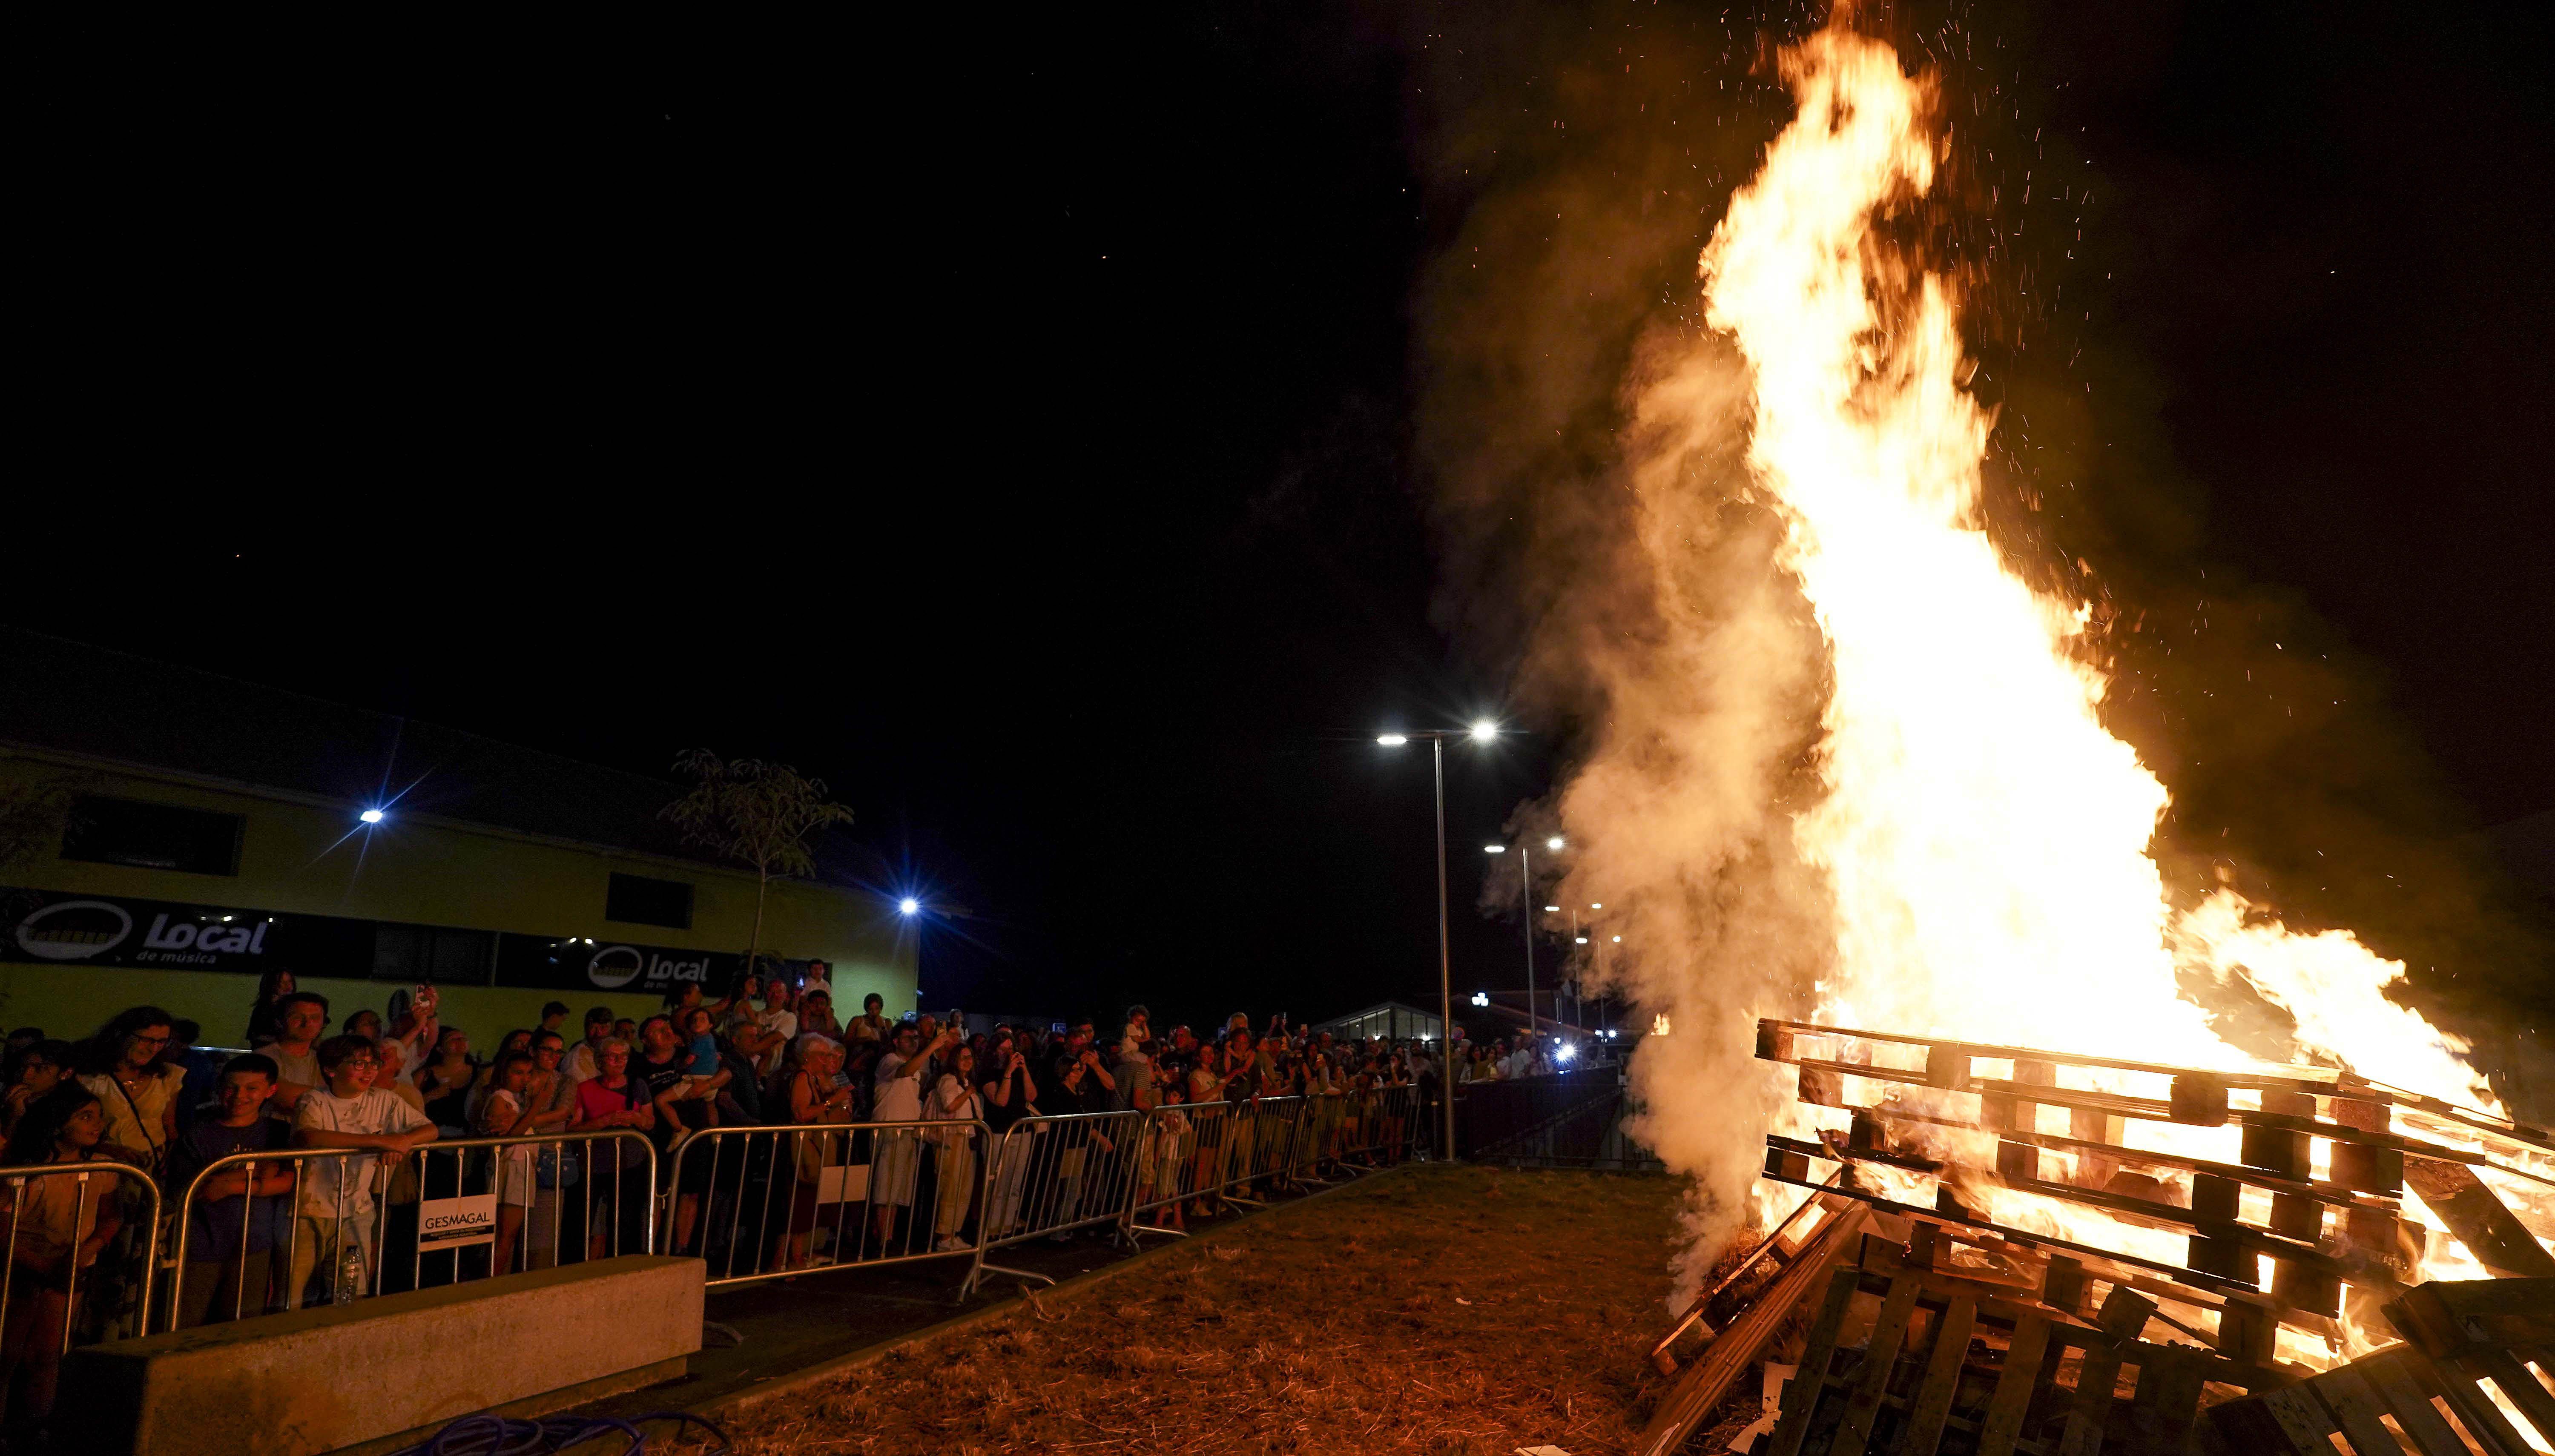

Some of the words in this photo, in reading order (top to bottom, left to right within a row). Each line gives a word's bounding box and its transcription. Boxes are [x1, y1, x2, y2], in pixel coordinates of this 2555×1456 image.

[142, 913, 269, 954] Local
[160, 951, 217, 964] música
[647, 953, 710, 982] Local
[425, 1212, 490, 1229] GESMAGAL
